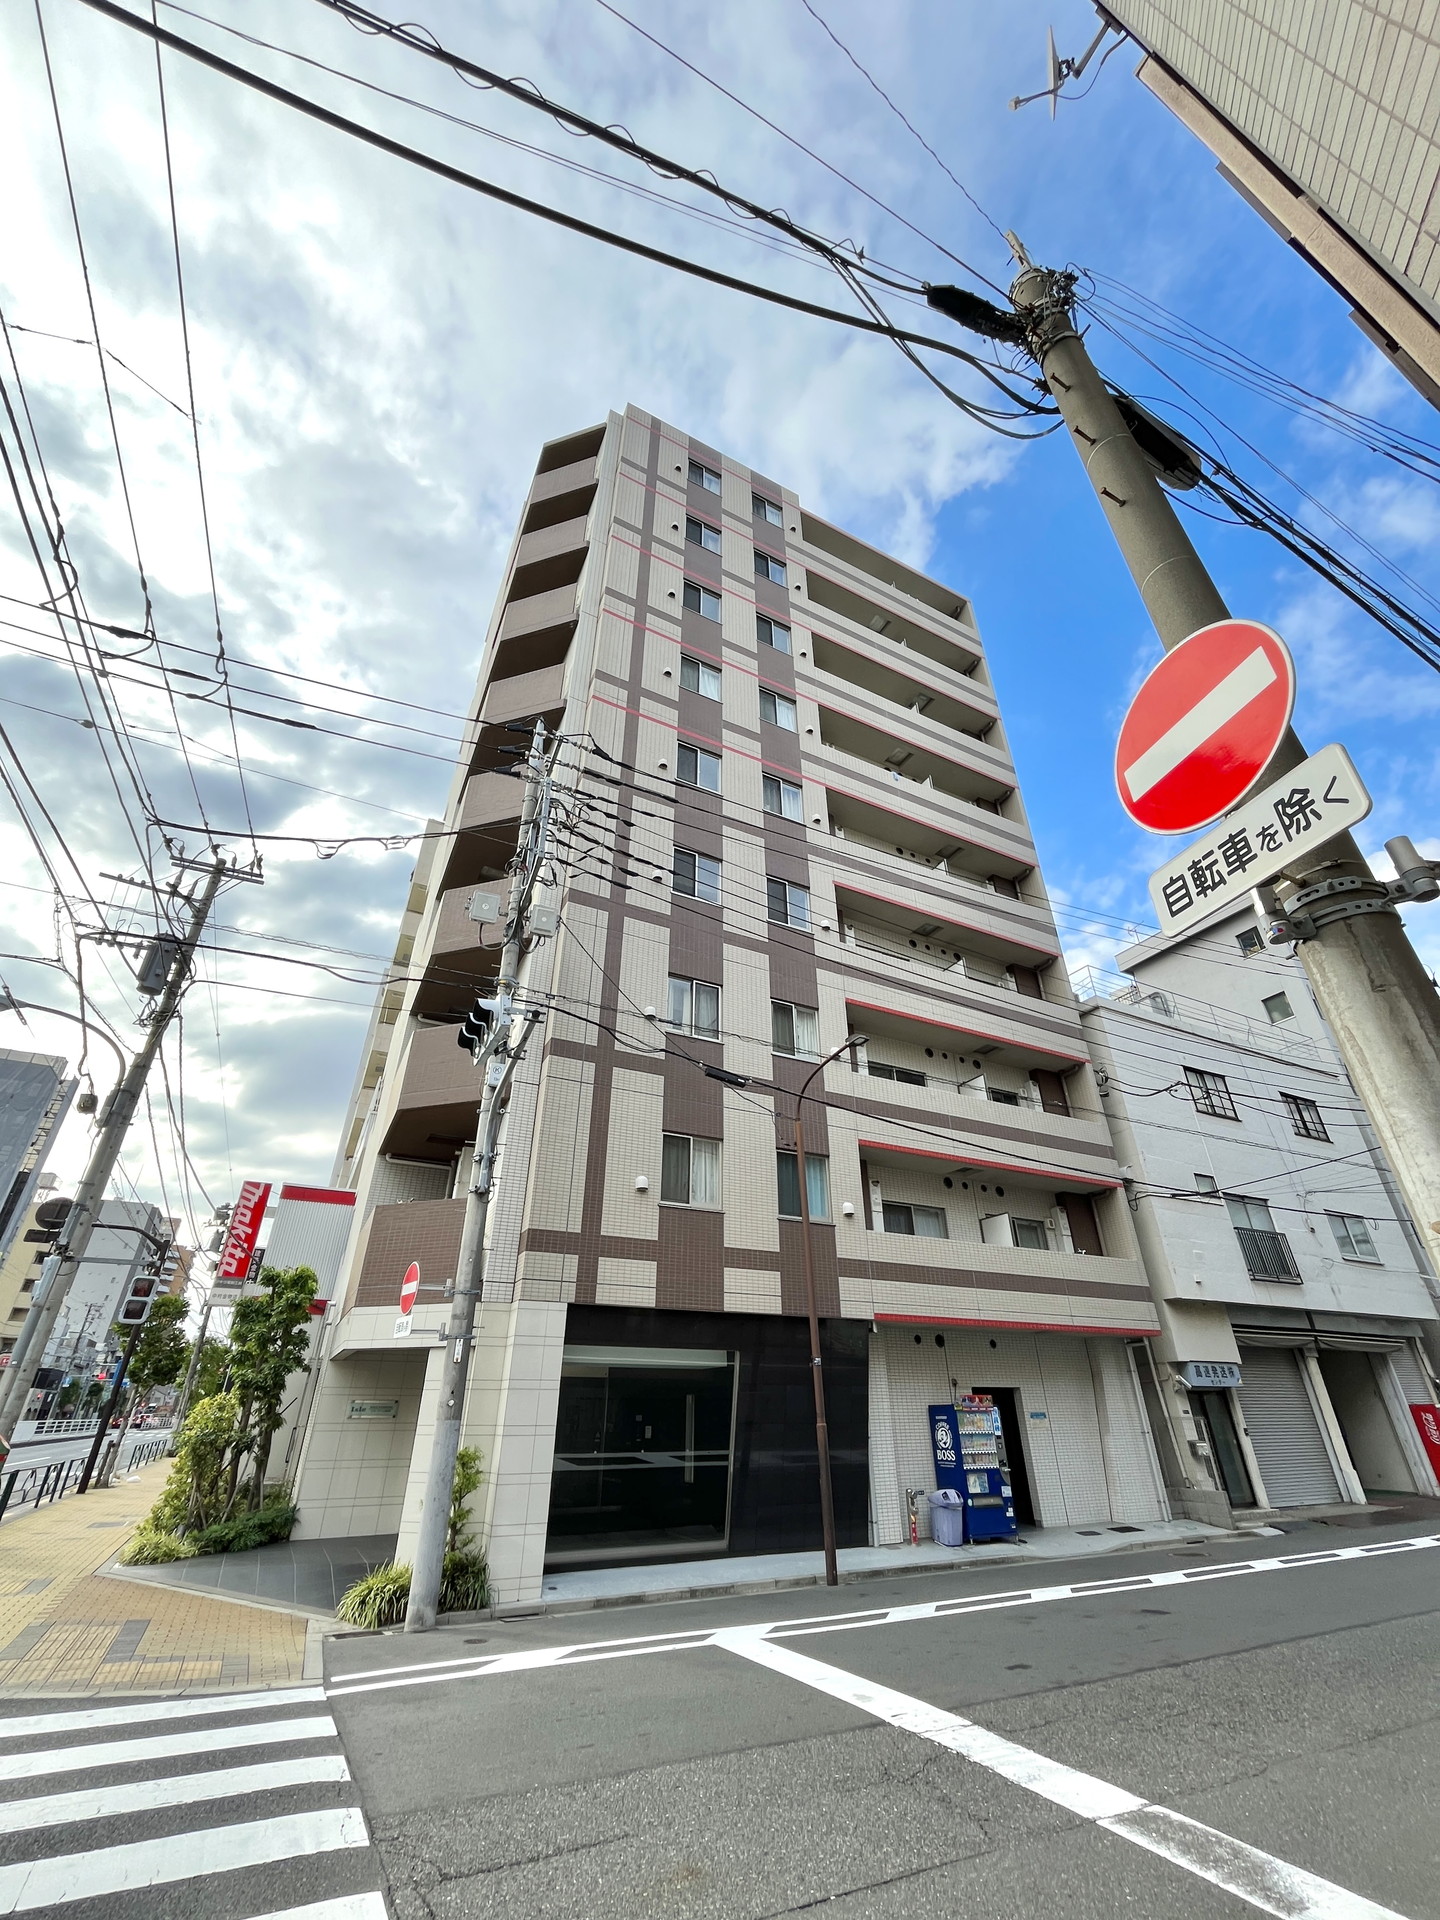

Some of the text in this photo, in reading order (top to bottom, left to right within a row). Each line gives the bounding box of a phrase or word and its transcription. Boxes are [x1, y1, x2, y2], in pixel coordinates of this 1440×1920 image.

[1161, 775, 1350, 919] 自転車を除く
[217, 1183, 265, 1277] makita
[936, 1449, 956, 1461] BOSS
